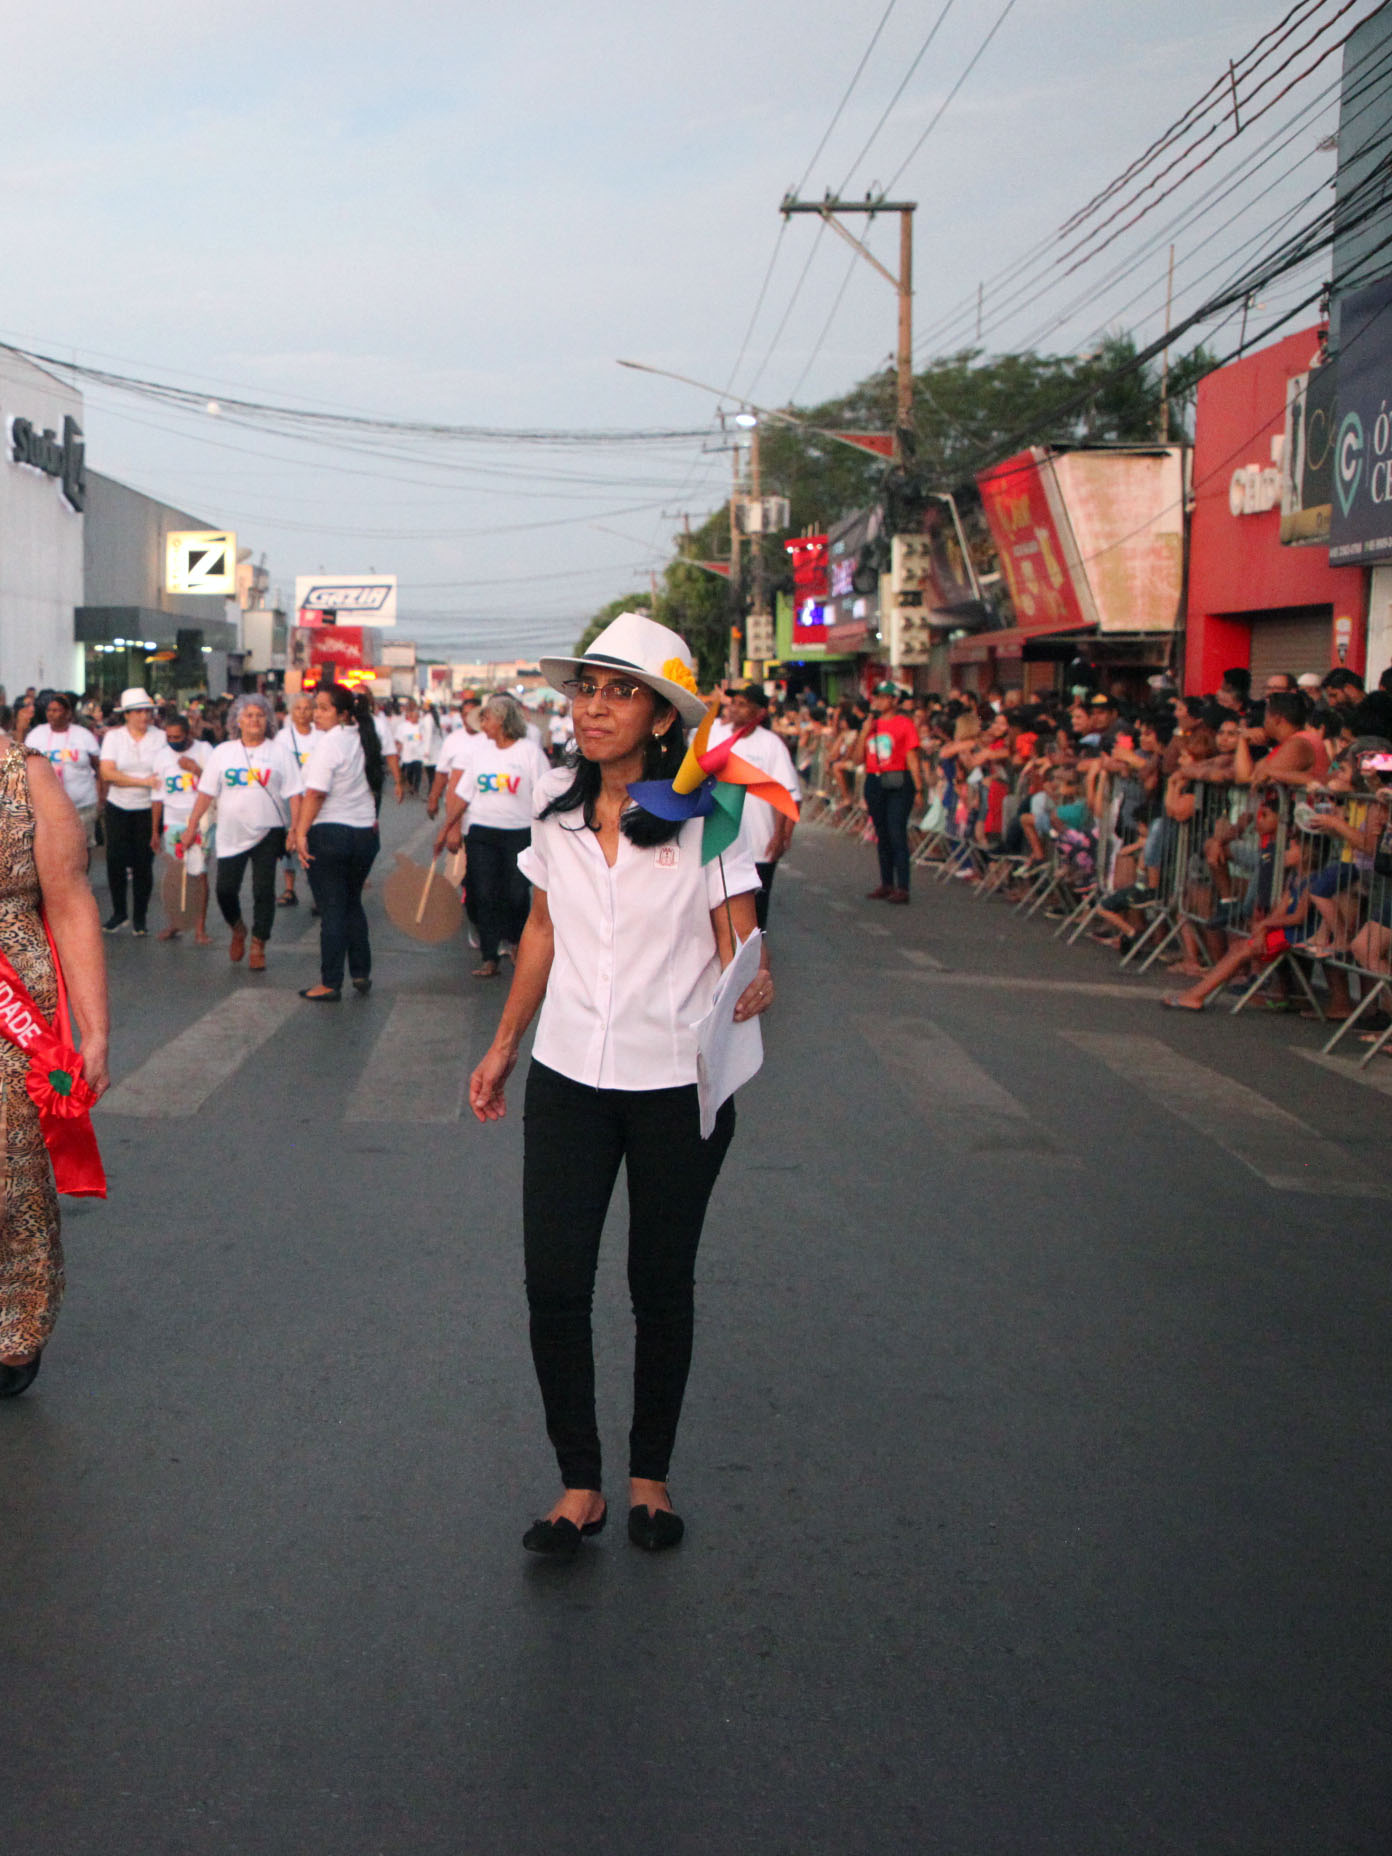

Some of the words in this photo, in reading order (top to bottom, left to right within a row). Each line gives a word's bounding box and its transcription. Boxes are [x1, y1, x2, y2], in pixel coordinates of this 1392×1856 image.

[42, 749, 79, 763] CFV
[225, 767, 272, 787] SCFV
[477, 772, 521, 795] SCFV
